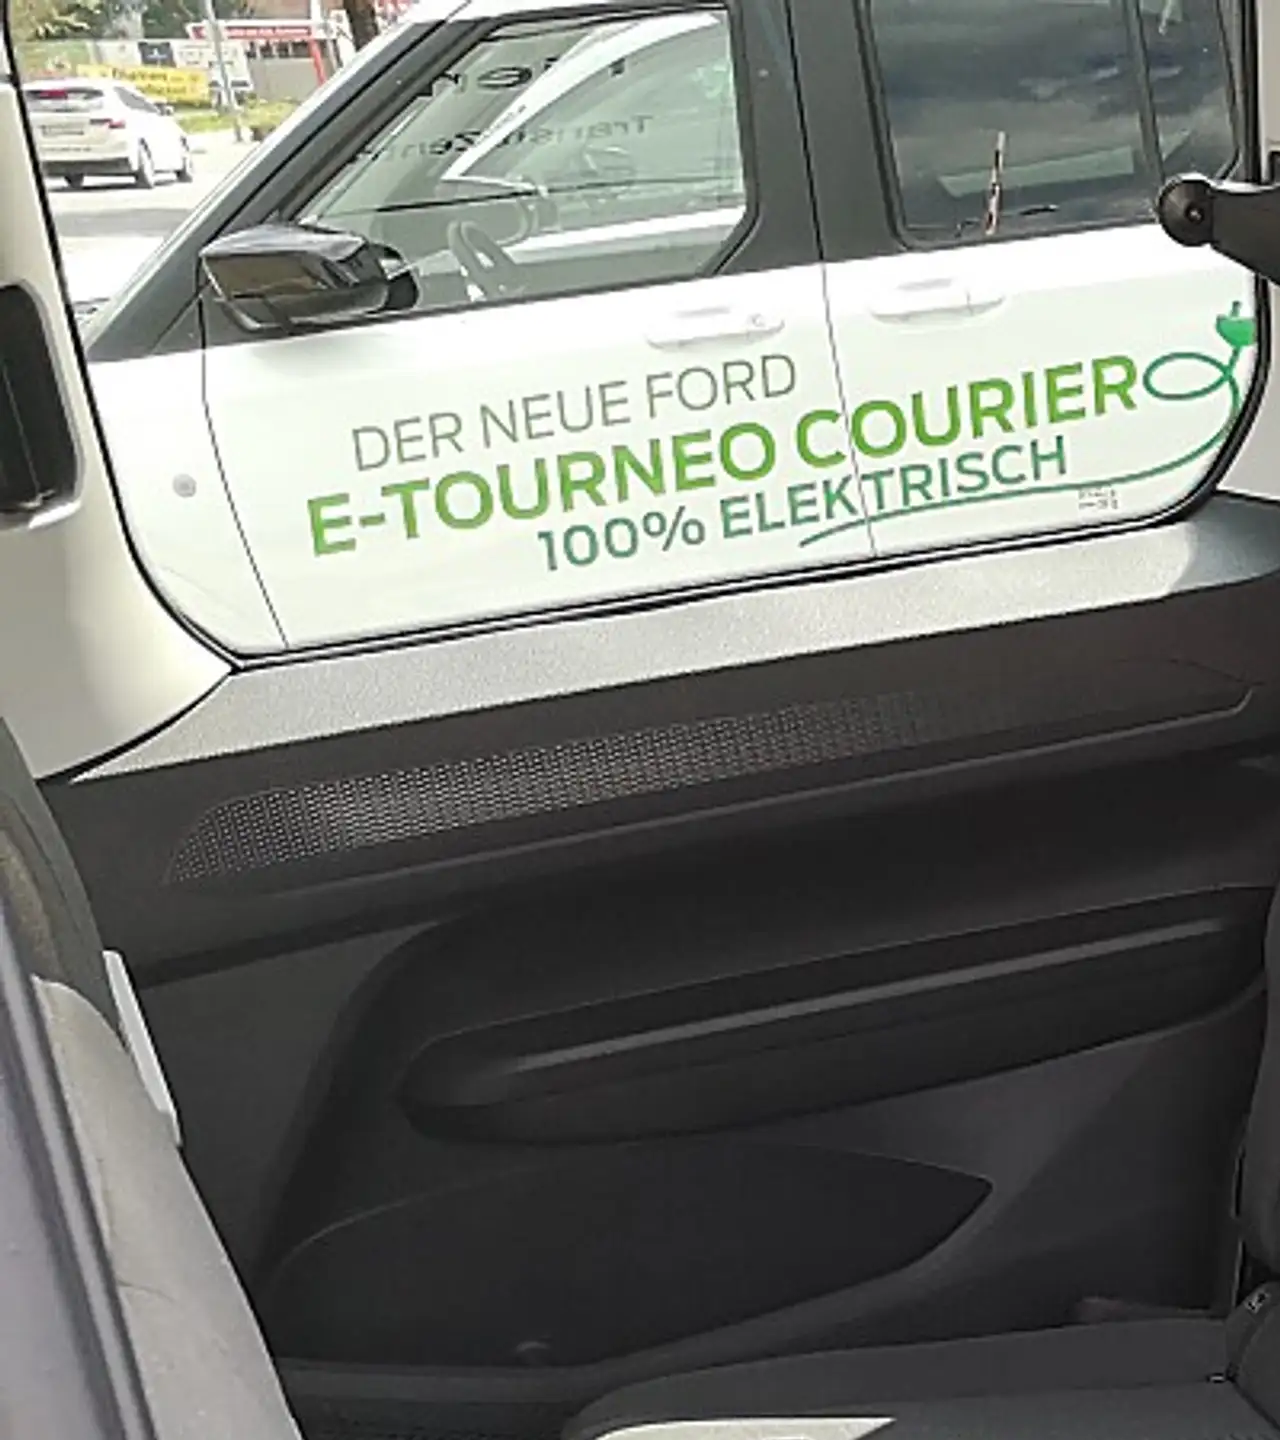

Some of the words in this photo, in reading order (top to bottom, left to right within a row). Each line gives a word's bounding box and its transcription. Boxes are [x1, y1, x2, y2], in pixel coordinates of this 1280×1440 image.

[306, 421, 777, 558] E-TOURNEO
[796, 355, 1138, 469] COURIER
[352, 411, 464, 473] DER
[479, 379, 631, 449] NEUE
[646, 352, 799, 419] FORD
[537, 504, 707, 573] 100%
[719, 434, 1068, 540] ELEKTRISCH
